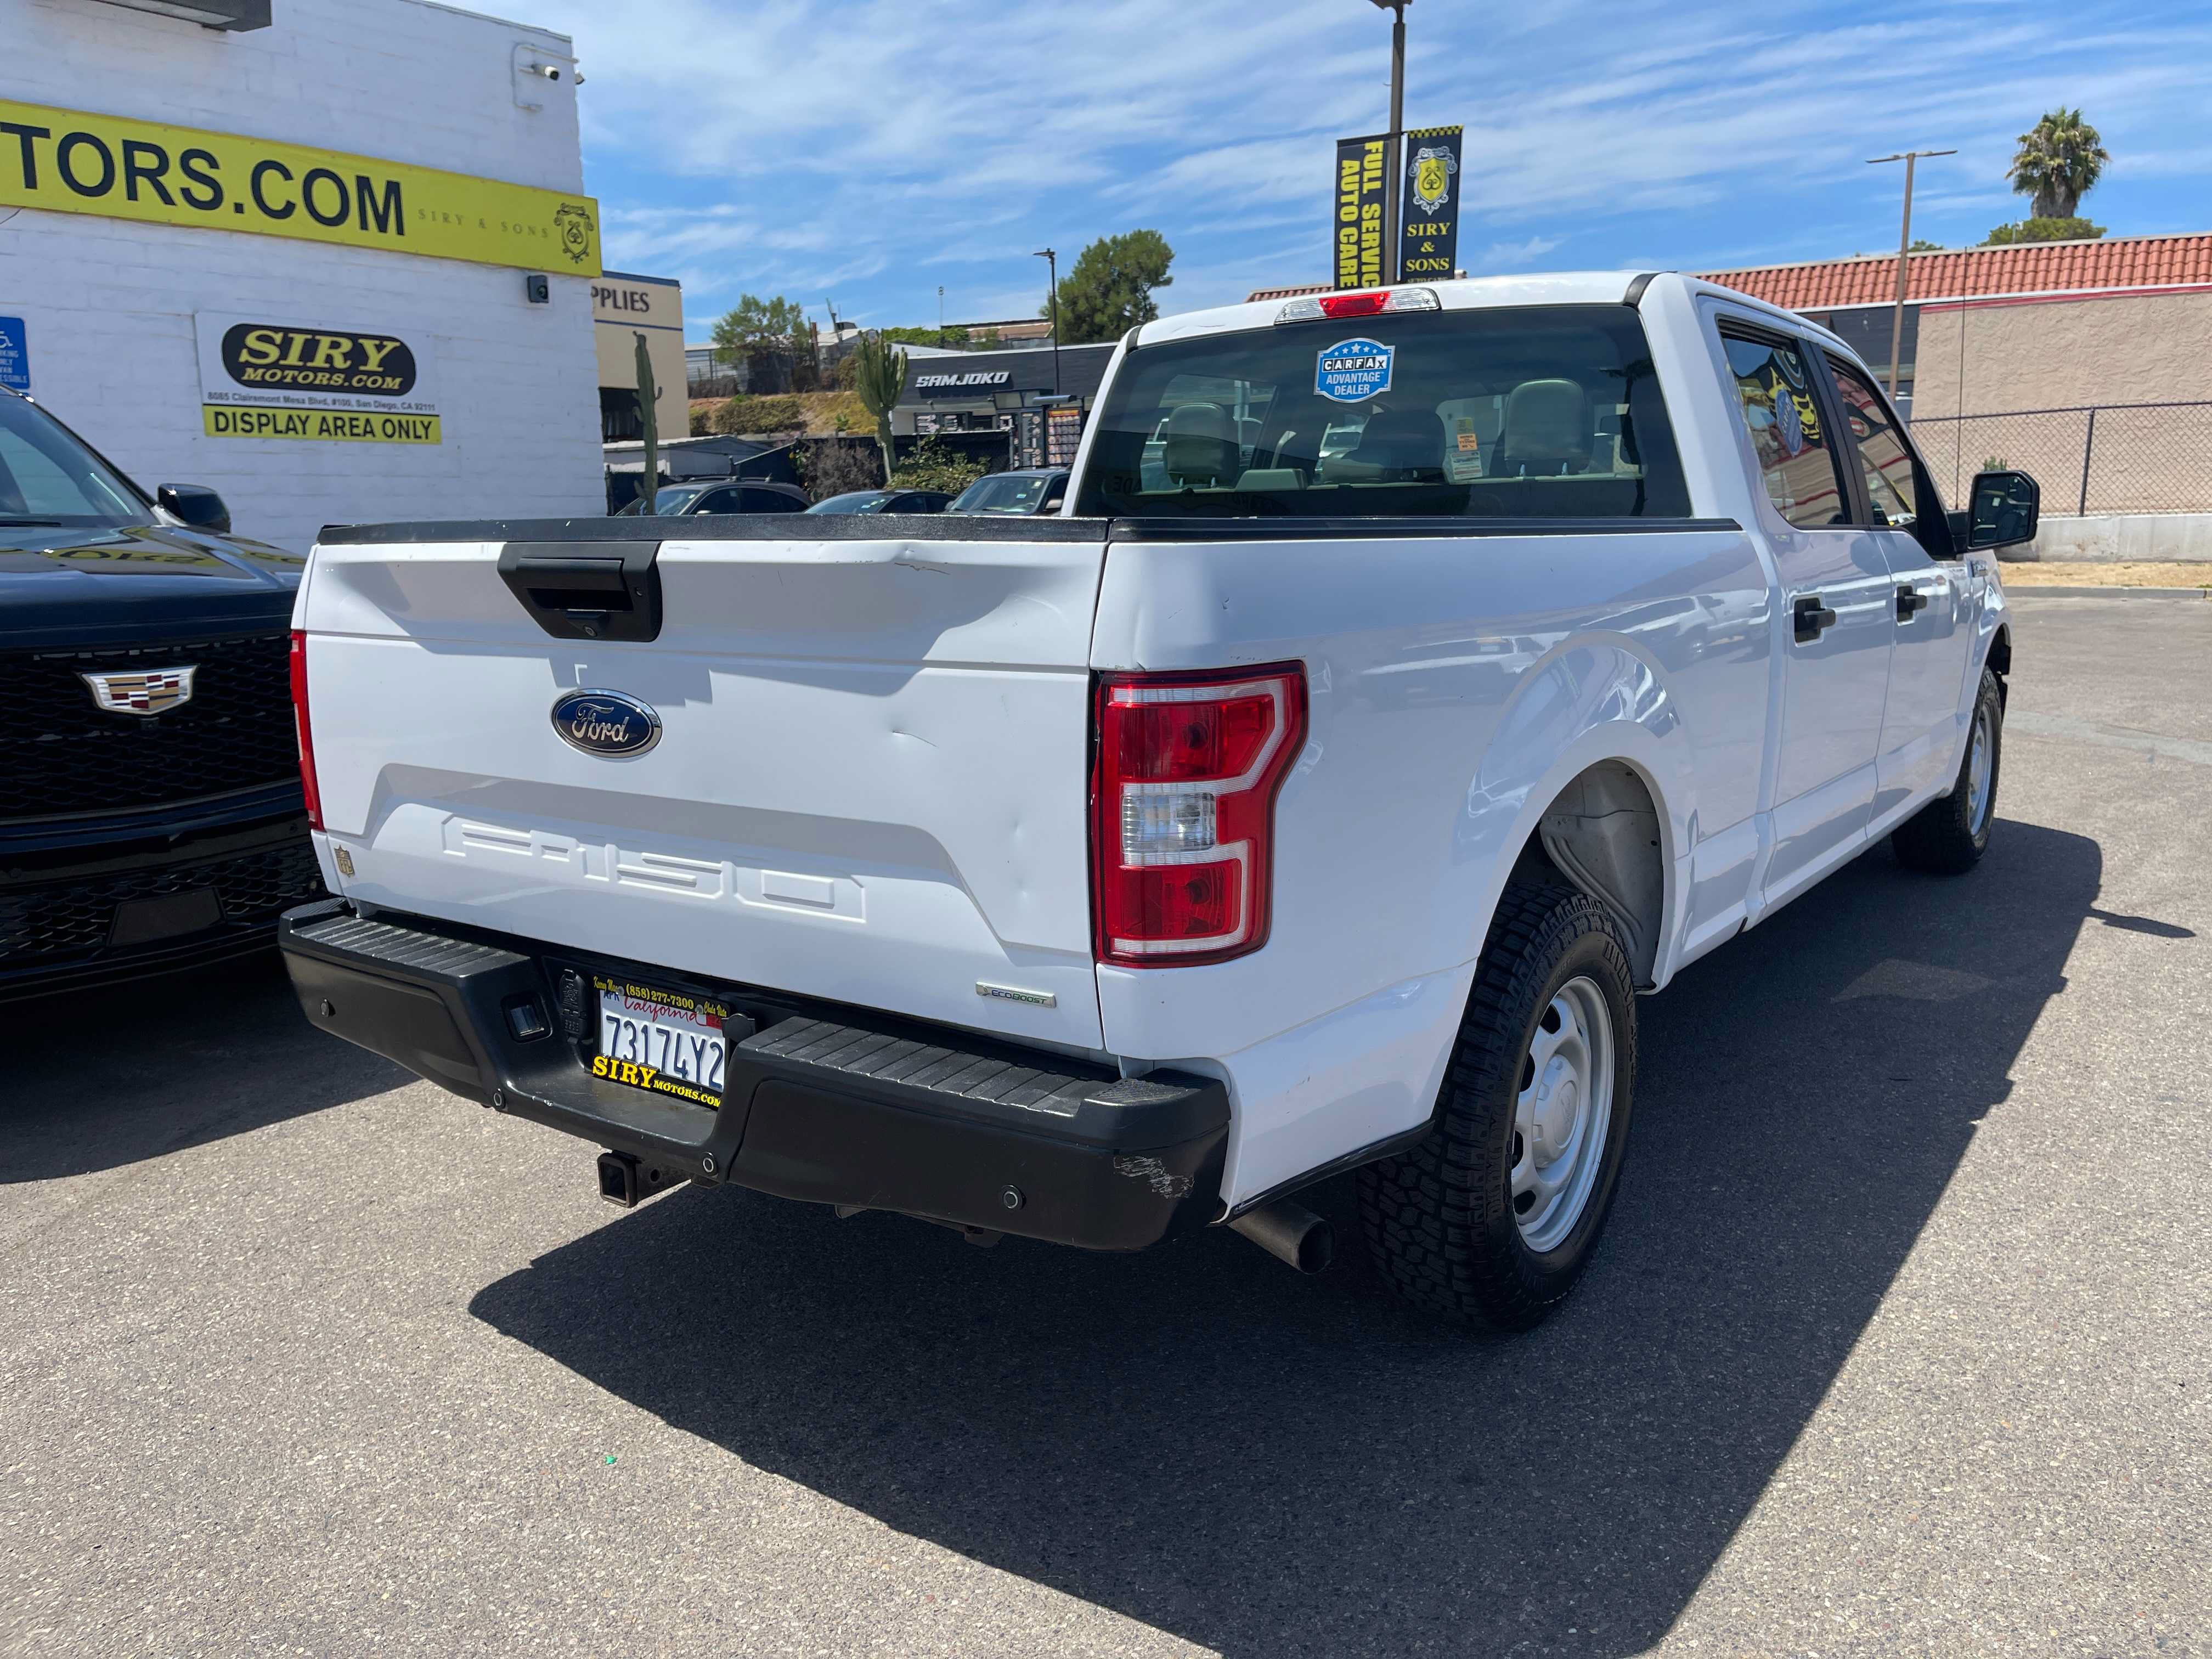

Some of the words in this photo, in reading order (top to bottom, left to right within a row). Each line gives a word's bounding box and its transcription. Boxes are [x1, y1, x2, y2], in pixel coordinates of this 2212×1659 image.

[0, 122, 405, 236] TORS.COM
[1362, 140, 1384, 194] FULL
[1340, 160, 1361, 222] AUTO
[418, 208, 464, 226] SIRY
[478, 218, 487, 229] &
[500, 221, 548, 238] SONS
[1407, 222, 1451, 237] SIRY
[1339, 227, 1358, 288] CARE
[1420, 241, 1436, 253] &
[1406, 258, 1450, 272] SONS
[238, 329, 401, 372] SIRY
[1323, 357, 1386, 371] CARFAX
[241, 367, 404, 390] MOTORS.COM
[915, 371, 1009, 387] SAMJOKO
[1326, 372, 1380, 384] ADVANTAGE
[1334, 384, 1370, 396] DEALER
[283, 396, 306, 404] Mesa
[356, 399, 373, 408] San
[401, 402, 413, 410] CA
[214, 411, 310, 435] DISPLAY
[318, 415, 376, 438] AREA
[382, 418, 432, 439] ONLY
[571, 703, 630, 743] Ford
[626, 984, 650, 1000] (858)
[651, 991, 693, 1009] 277-7300
[991, 989, 1047, 1004] ECOBOOST
[624, 996, 707, 1026] California
[606, 1014, 723, 1090] 73174Y2
[592, 1056, 657, 1089] SIRY
